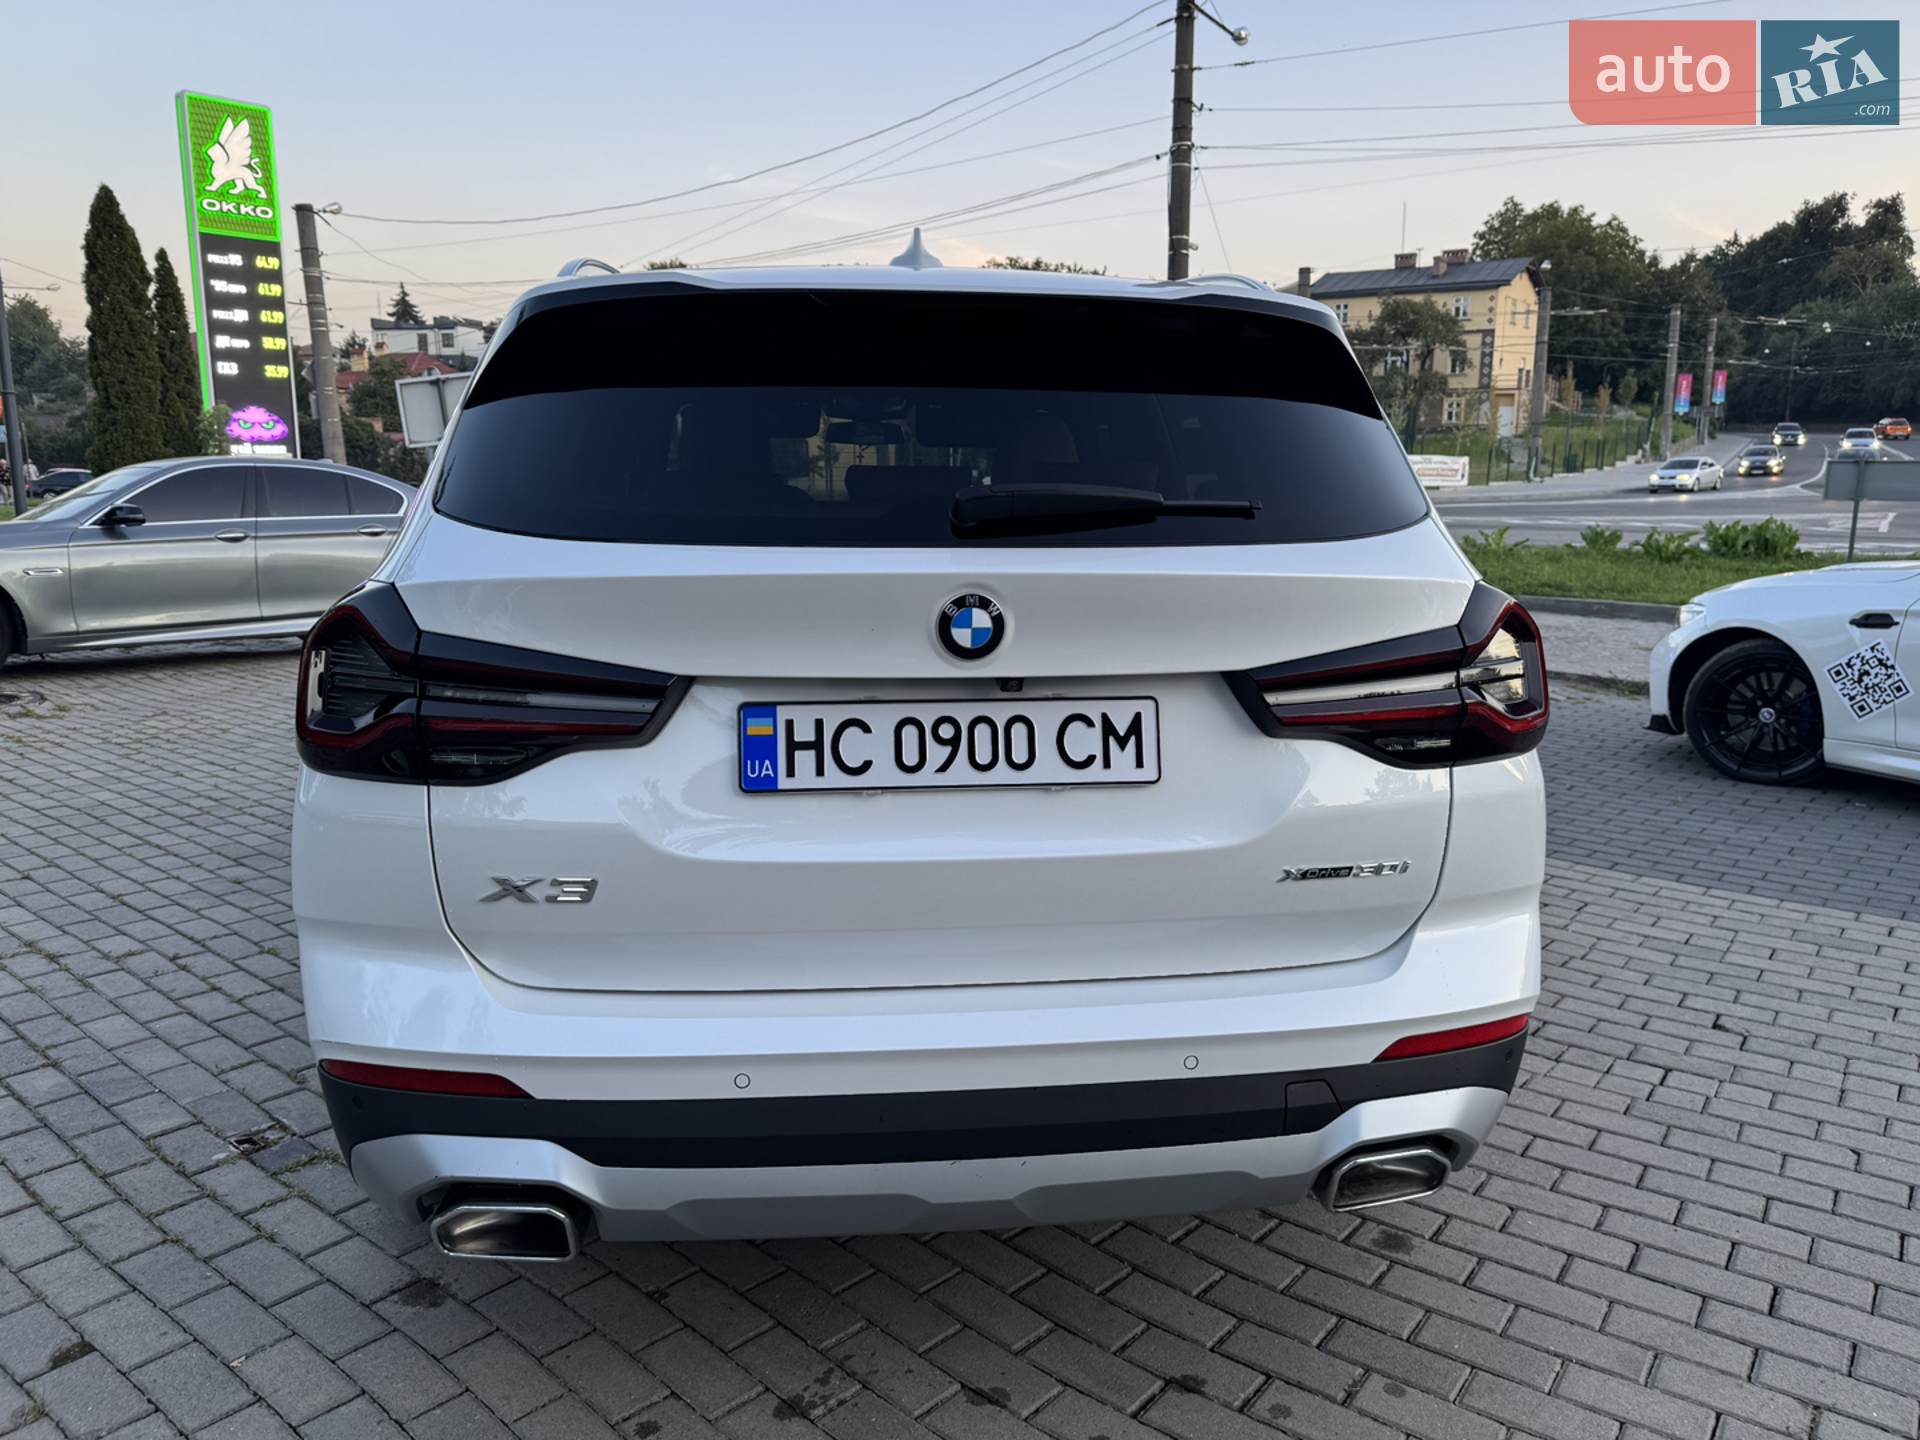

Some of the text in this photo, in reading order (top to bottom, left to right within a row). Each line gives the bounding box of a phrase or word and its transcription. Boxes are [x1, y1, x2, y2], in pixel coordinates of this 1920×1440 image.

[201, 198, 274, 219] OKKO
[943, 594, 1001, 618] BMW
[746, 710, 1145, 779] UA HC 0900 CM
[478, 874, 600, 904] X3
